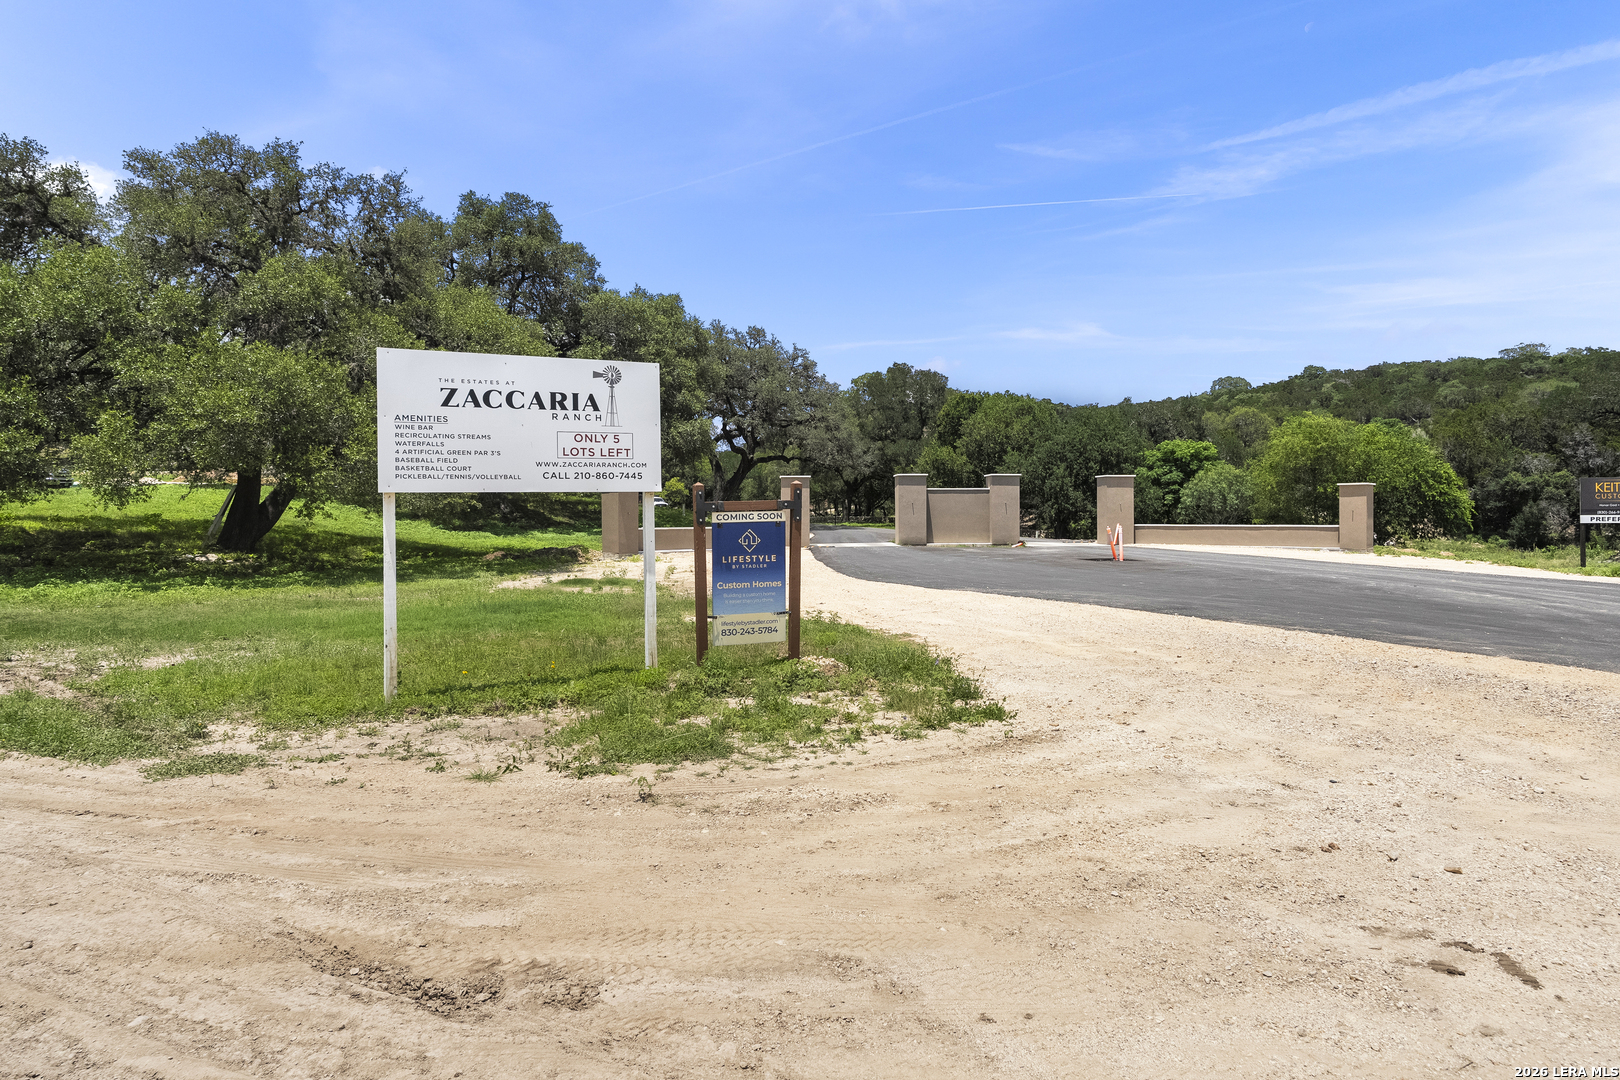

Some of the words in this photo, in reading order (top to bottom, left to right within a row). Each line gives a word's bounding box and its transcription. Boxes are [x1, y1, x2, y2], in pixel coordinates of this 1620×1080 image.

[460, 378, 500, 386] ESTATES
[440, 387, 601, 412] ZACCARIA
[394, 414, 449, 423] AMENITIES
[551, 412, 602, 422] RANCH
[394, 432, 456, 440] RECIRCULATING
[457, 433, 492, 441] STREAMS
[573, 433, 609, 444] ONLY
[613, 434, 621, 444] 5
[394, 440, 445, 448] WATERFALLS
[562, 446, 596, 457] LOTS
[599, 447, 632, 458] LEFT
[535, 461, 648, 469] WWW.ZACCARIARANCH.COM
[394, 473, 522, 481] PICKLEBALL/TENNIS/VOLLEYBALL
[542, 471, 571, 480] CALL
[573, 471, 644, 481] 210-860-7445
[716, 512, 755, 521] COMING
[756, 512, 783, 520] SOON
[722, 554, 776, 563] LIFESTYLE
[717, 582, 751, 590] Custom
[752, 580, 782, 588] Homes
[720, 619, 779, 627] lifestylebystadler.com
[720, 626, 778, 636] 830-243-5784
